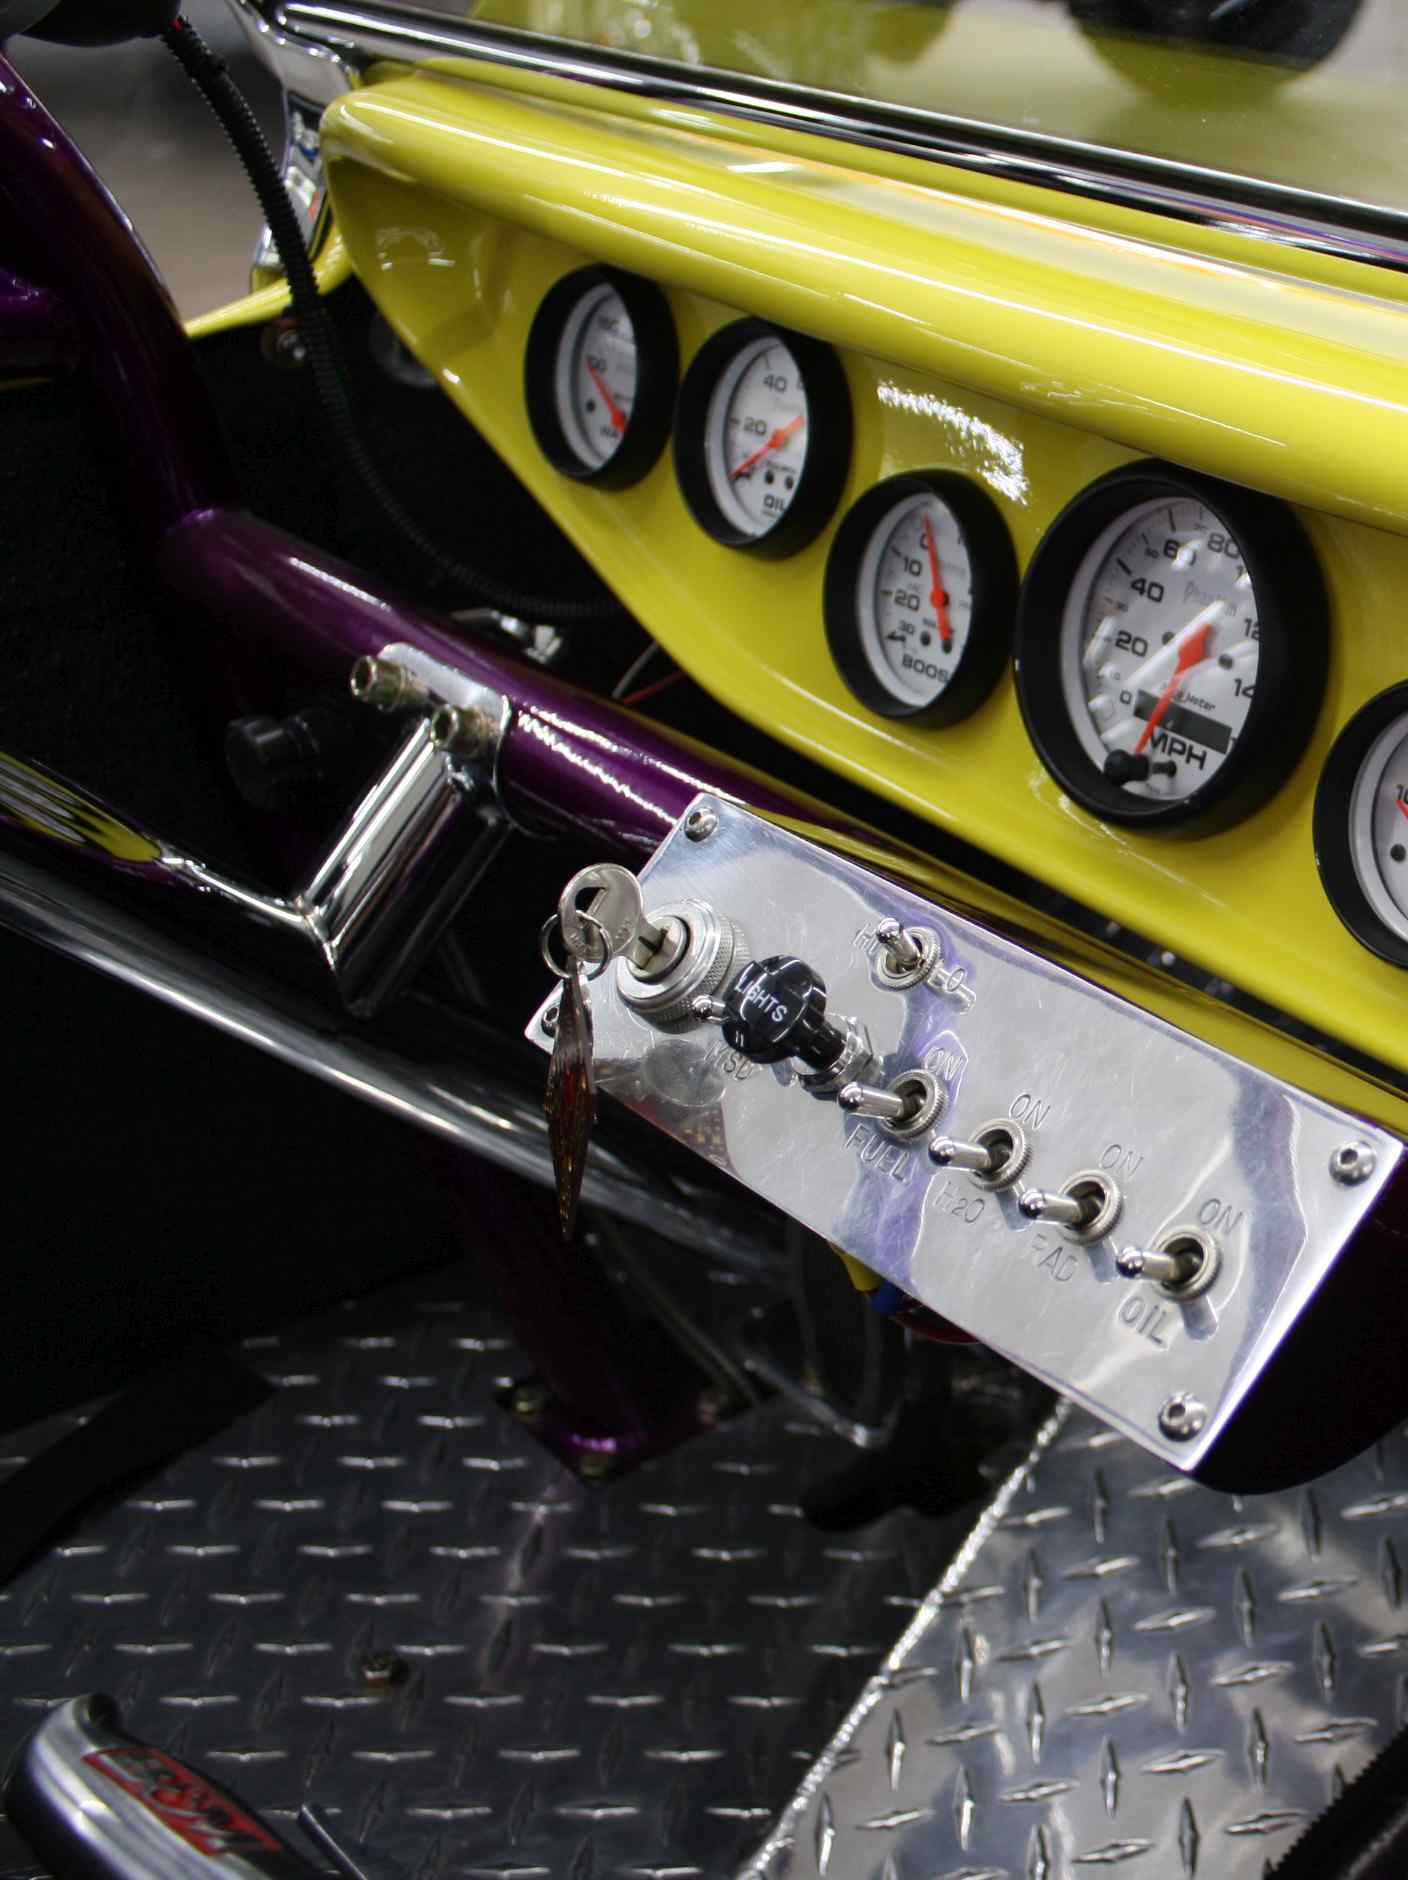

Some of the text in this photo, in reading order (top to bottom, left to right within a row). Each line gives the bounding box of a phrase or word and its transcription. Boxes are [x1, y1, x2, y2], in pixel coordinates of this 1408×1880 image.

[763, 373, 787, 394] 40
[742, 416, 768, 437] 20
[1207, 532, 1239, 560] 80
[903, 556, 923, 578] 10
[894, 589, 921, 613] 20
[1130, 577, 1164, 604] 40
[1115, 630, 1149, 658] 20
[1150, 731, 1208, 771] MPH
[734, 964, 789, 1023] LIGHTS
[924, 1045, 965, 1083] ON
[1009, 1093, 1051, 1130] ON
[843, 1122, 911, 1183] FUEL
[1101, 1144, 1145, 1180] ON
[1199, 1198, 1244, 1236] ON
[1120, 1295, 1170, 1345] OIL
